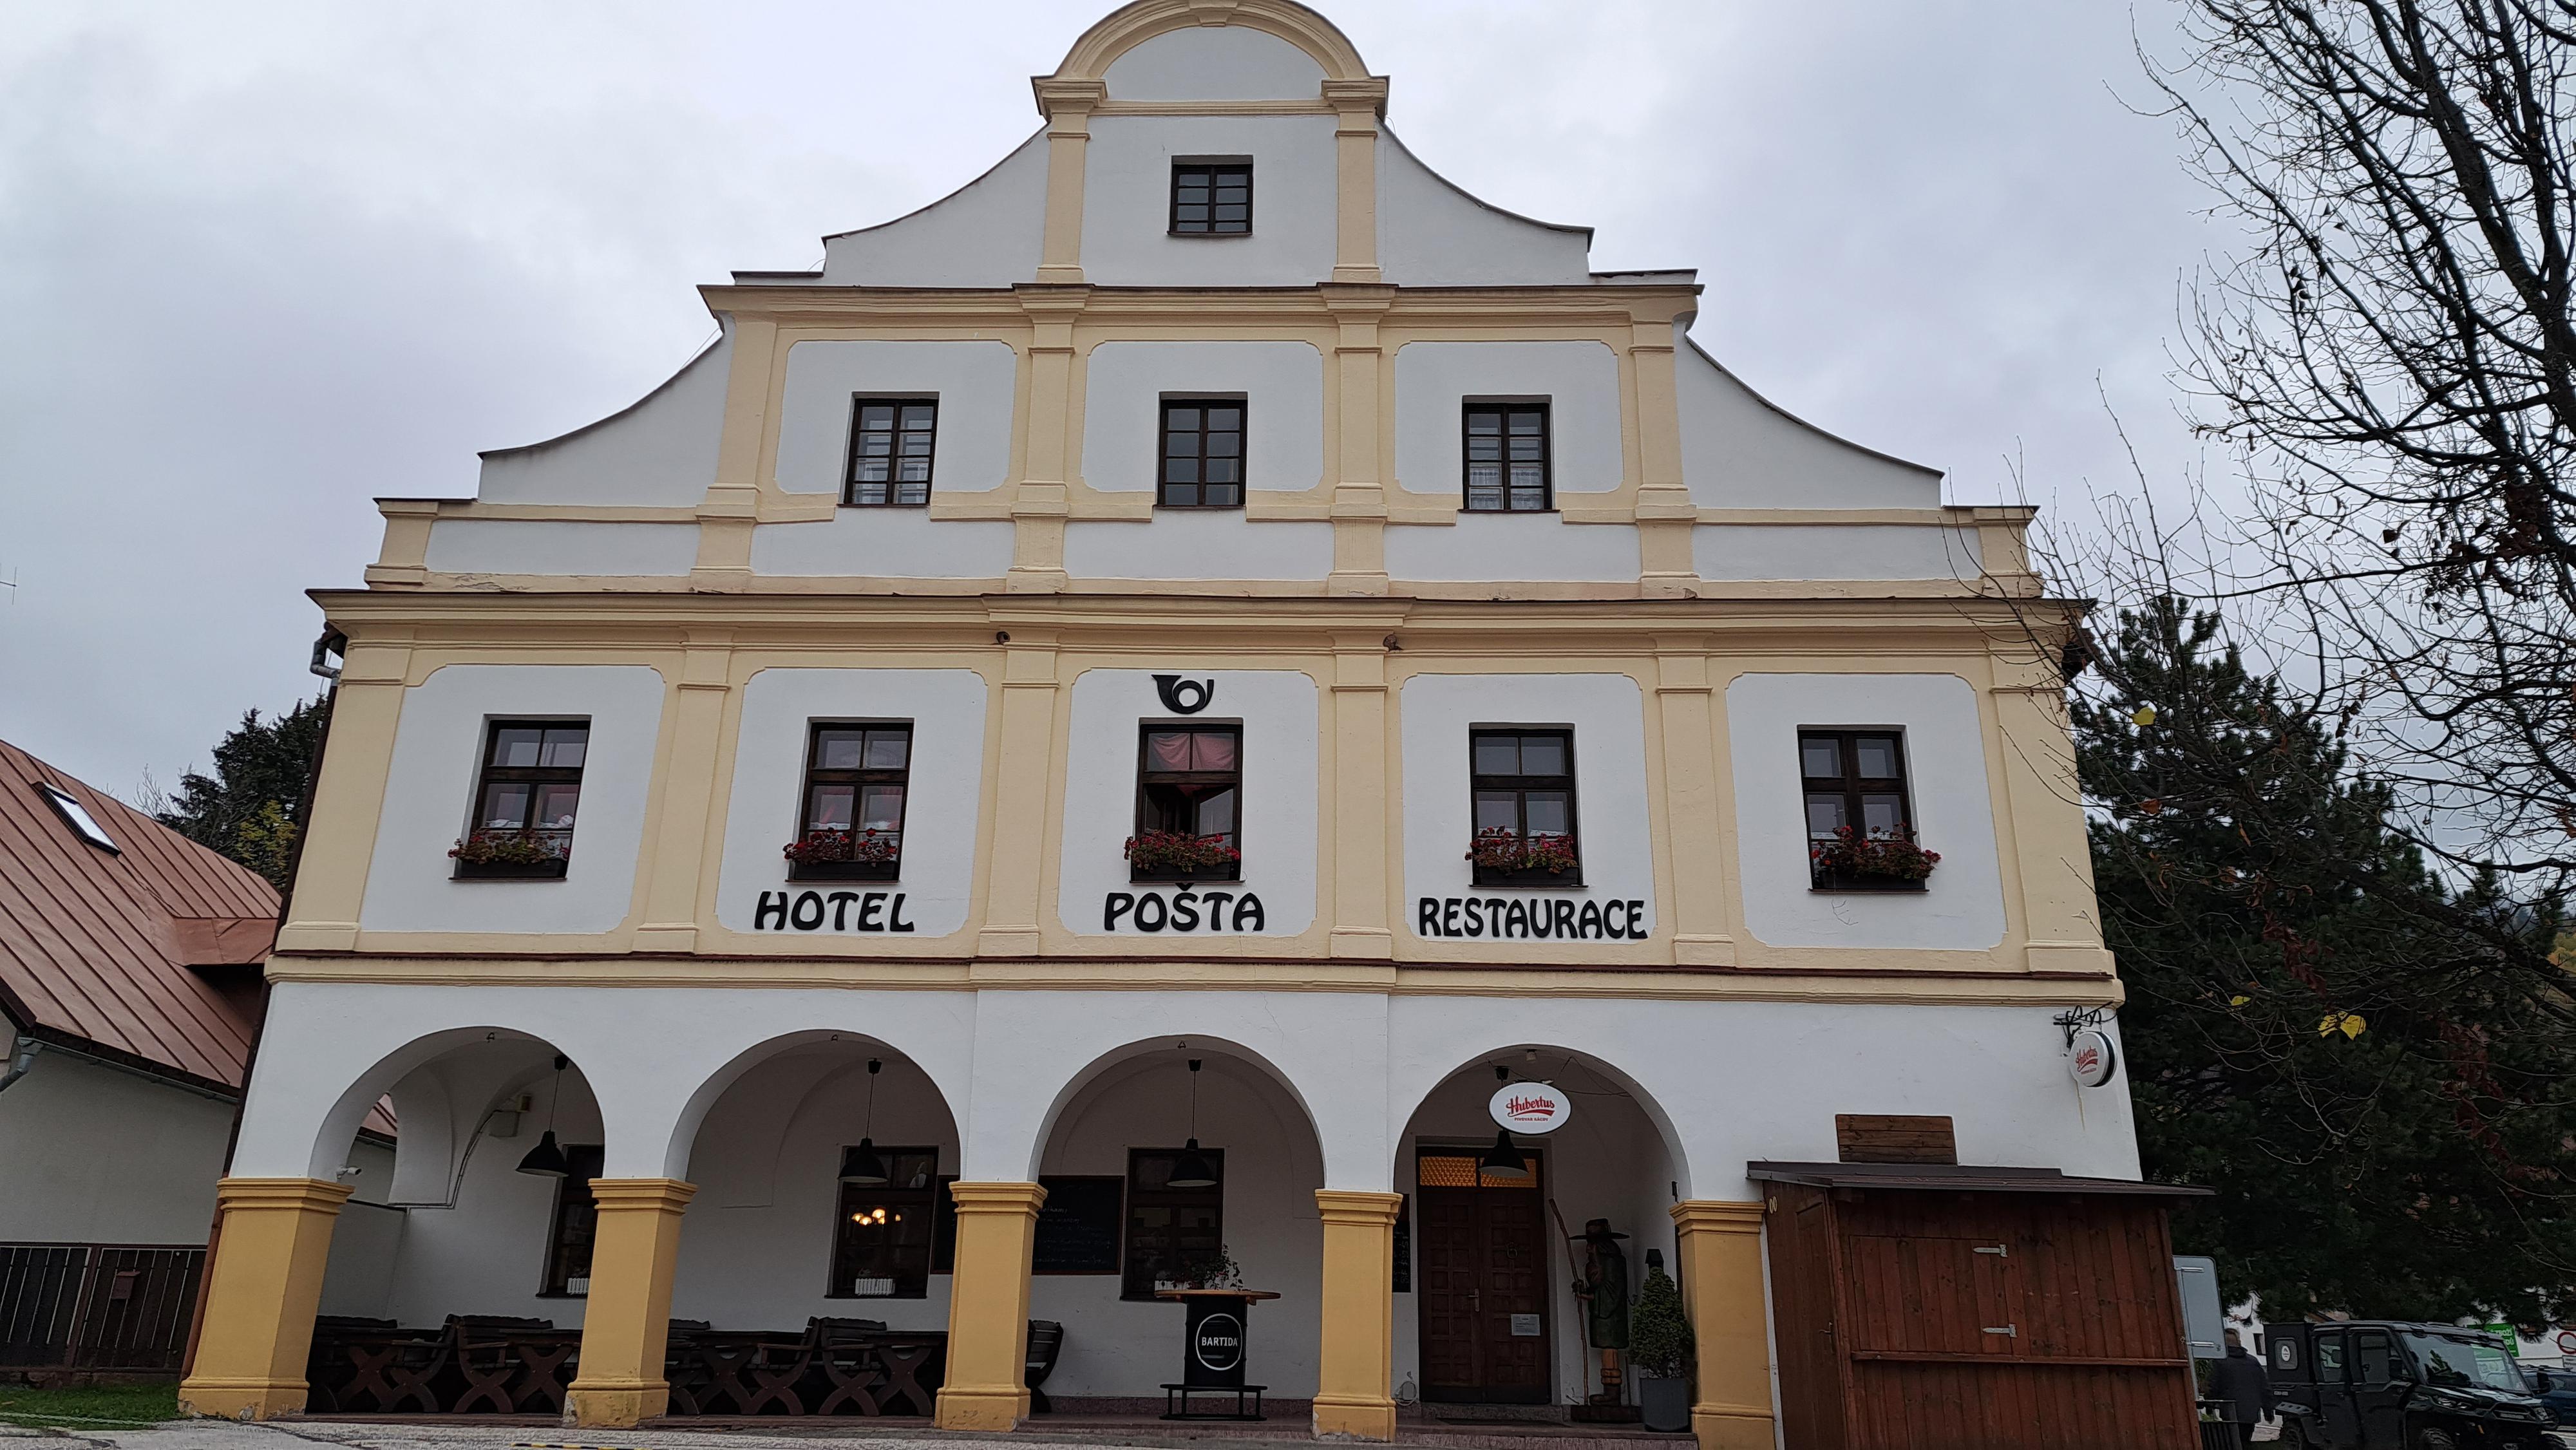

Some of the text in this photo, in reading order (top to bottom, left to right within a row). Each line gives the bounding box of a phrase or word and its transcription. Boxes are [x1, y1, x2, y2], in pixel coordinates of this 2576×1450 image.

[754, 890, 914, 932] HOTEL
[1104, 883, 1264, 932] POŠTA
[1419, 897, 1648, 939] RESTAURACE
[1506, 1095, 1555, 1115] Hubertus
[1201, 1337, 1238, 1347] BARTIDA
